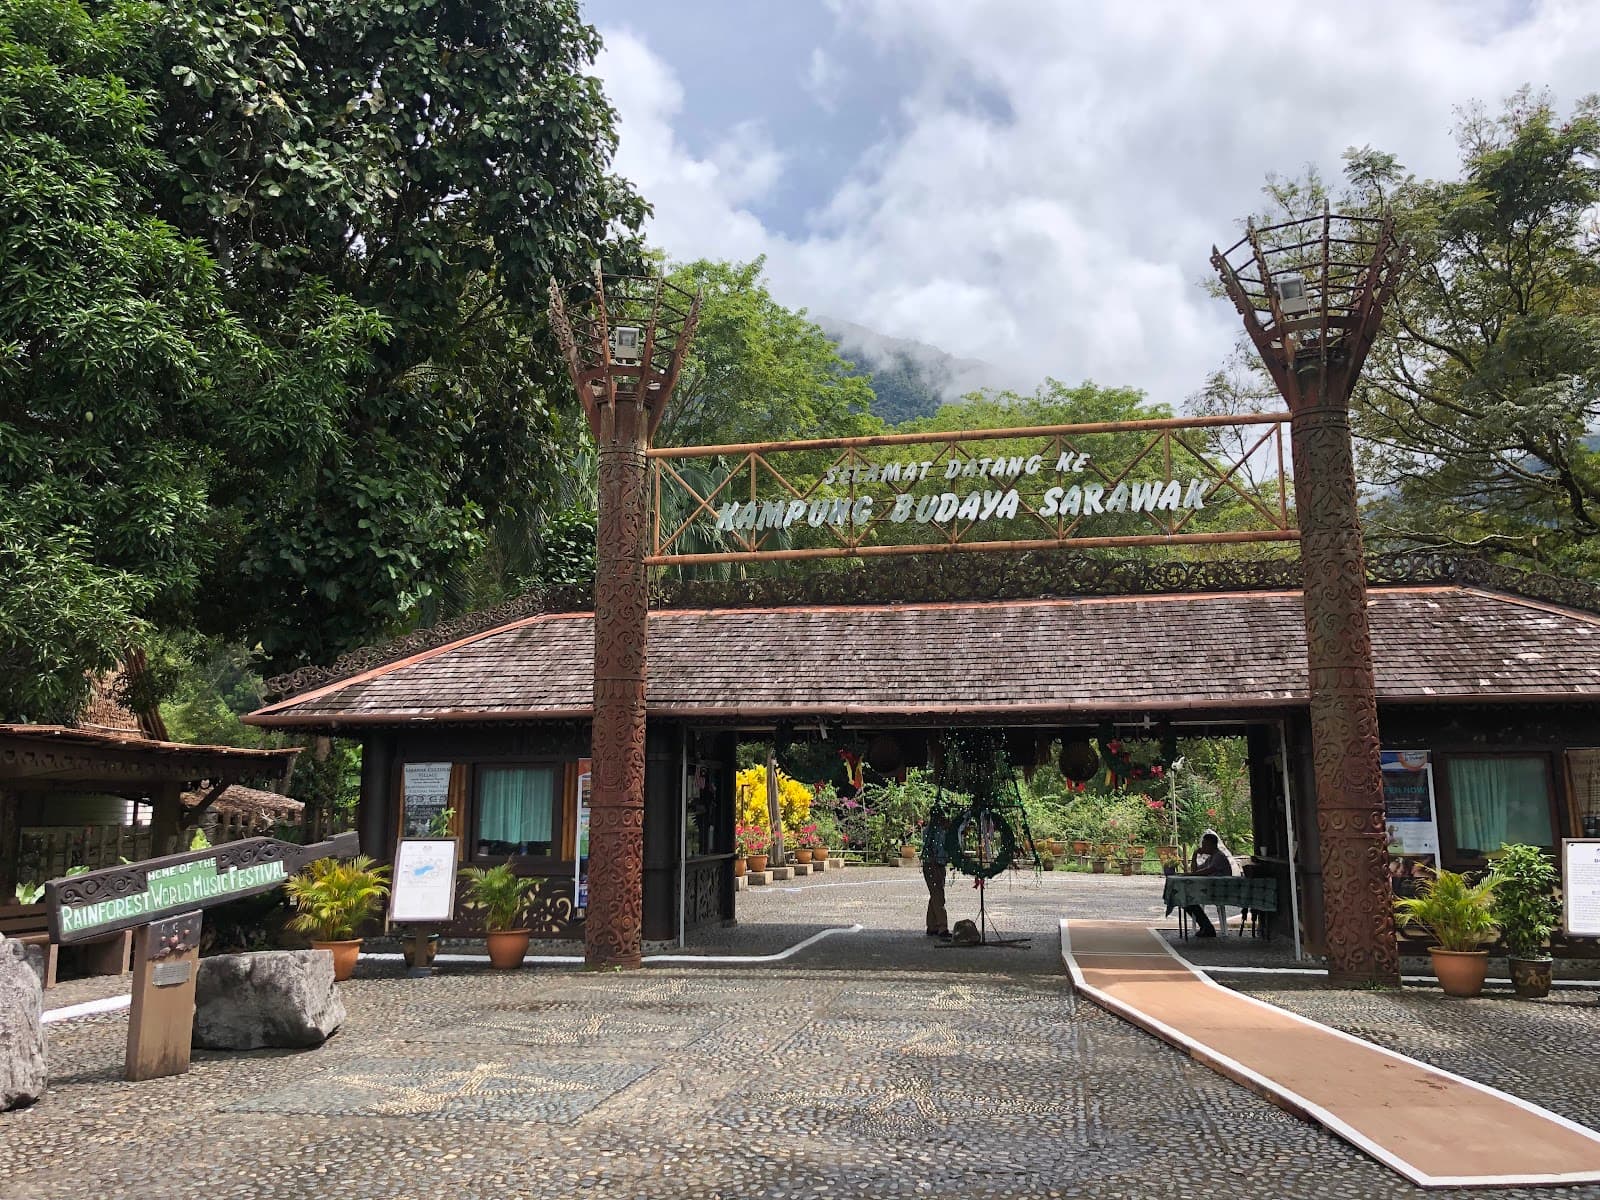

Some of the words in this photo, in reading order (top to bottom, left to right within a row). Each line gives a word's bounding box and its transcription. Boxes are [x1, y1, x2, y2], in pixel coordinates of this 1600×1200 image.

[824, 461, 933, 486] SELAMAT
[944, 455, 1042, 480] DATANG
[1055, 451, 1090, 473] KE
[716, 495, 873, 531] KAMPUNG
[890, 489, 1019, 524] BUDAYA
[1039, 478, 1209, 517] SARAWAK
[147, 866, 177, 881] HOME
[181, 863, 193, 874] OF
[199, 857, 217, 869] THE
[61, 891, 150, 932] RAINFOREST
[150, 882, 192, 910] WORLD
[193, 873, 229, 899] MUSIC
[229, 860, 288, 890] FESTIVAL
